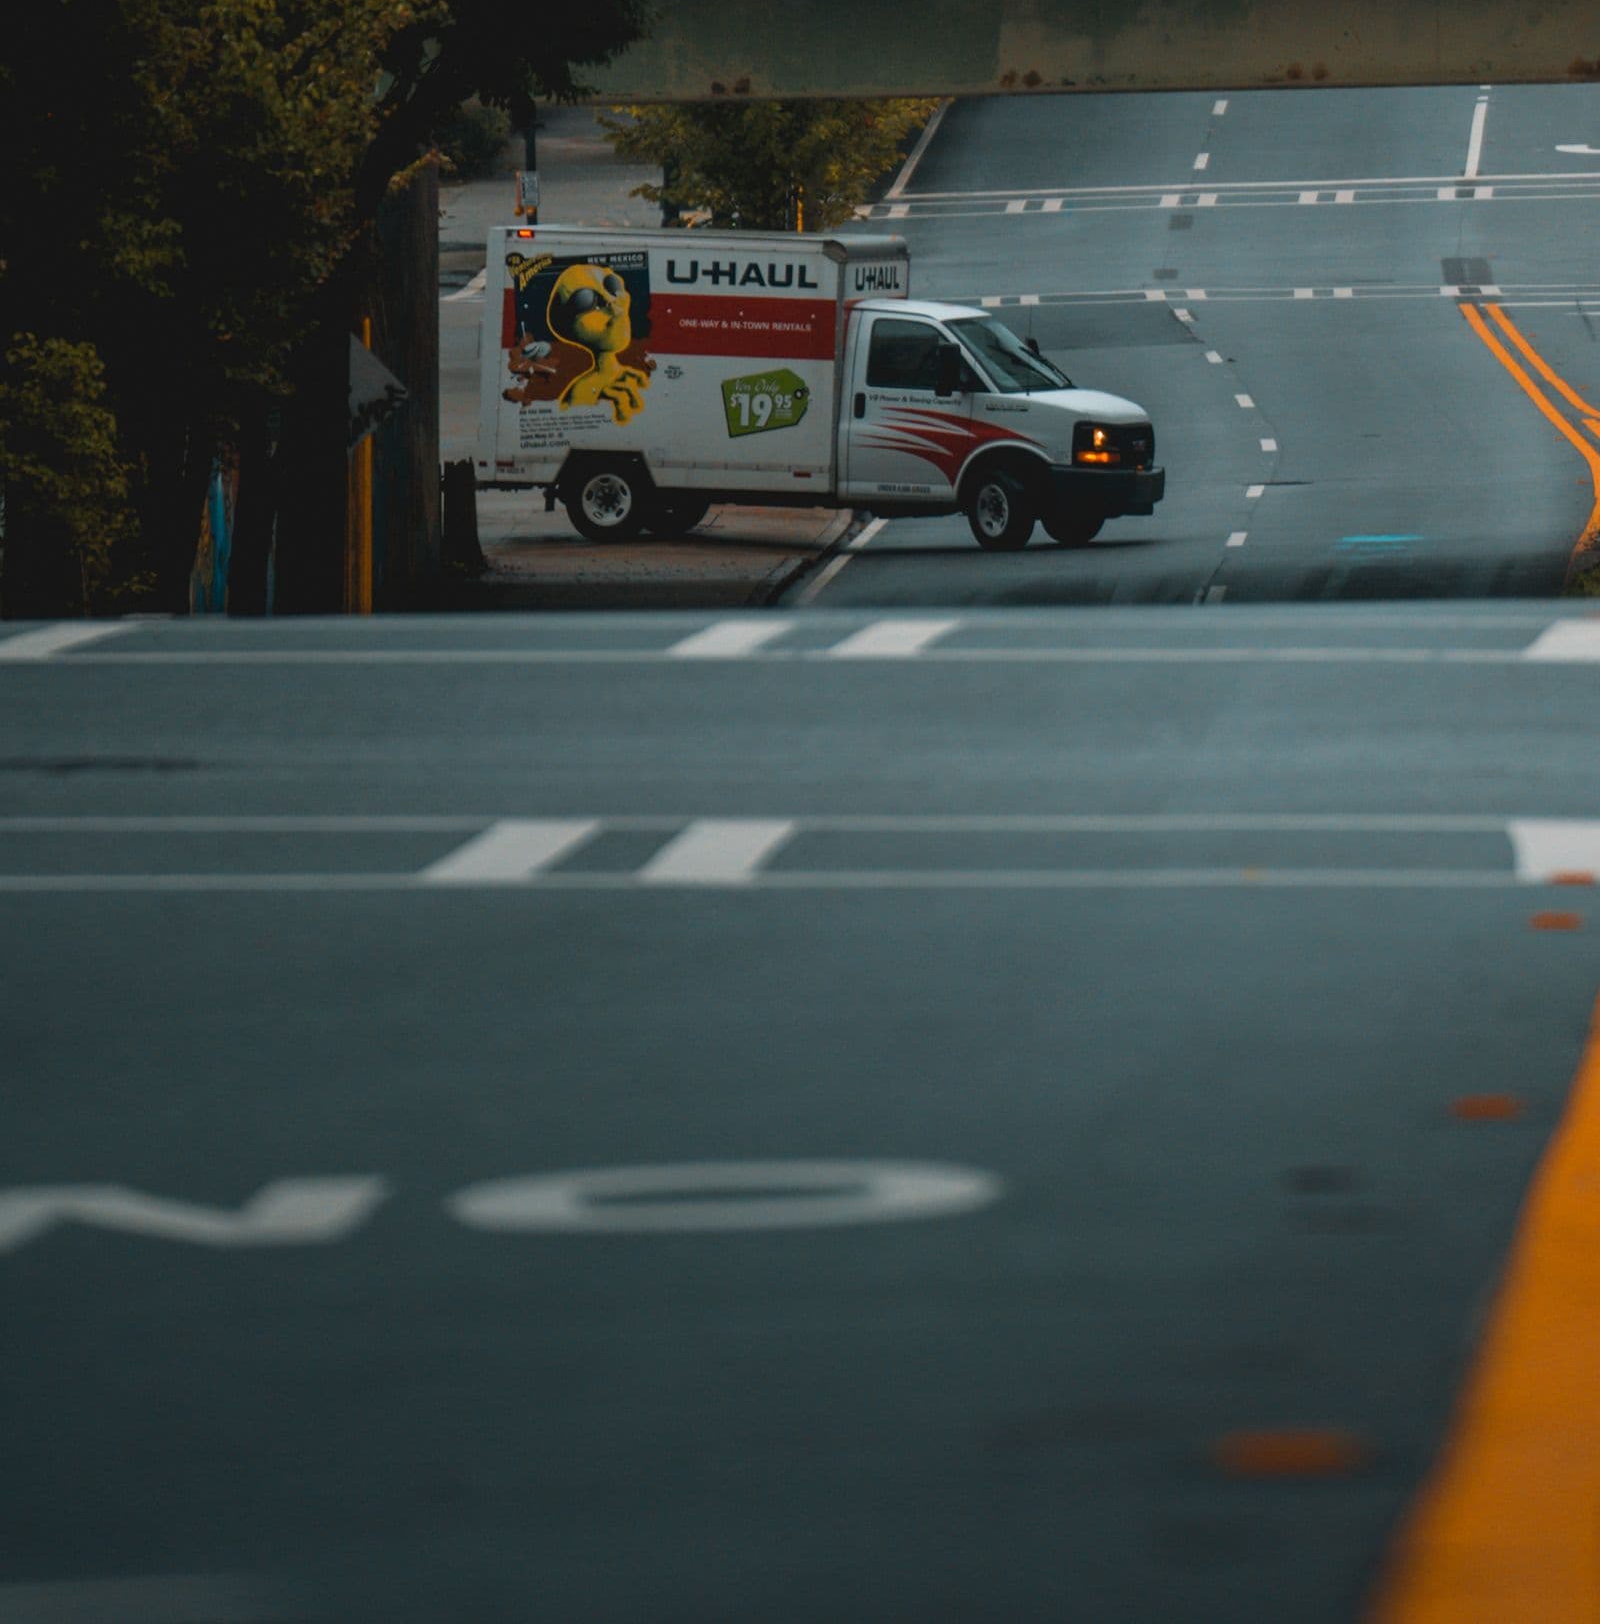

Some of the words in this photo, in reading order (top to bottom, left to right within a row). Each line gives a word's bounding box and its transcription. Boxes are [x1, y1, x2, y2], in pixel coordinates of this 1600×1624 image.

[610, 254, 644, 263] MEXICO
[666, 259, 818, 289] U-HAUL
[855, 266, 900, 291] U-HAUL
[679, 318, 720, 330] ONE-WAY
[721, 319, 729, 330] &
[730, 320, 770, 331] IN-TOWN
[772, 321, 812, 333] RENTALS
[520, 439, 571, 450] uhaul.com
